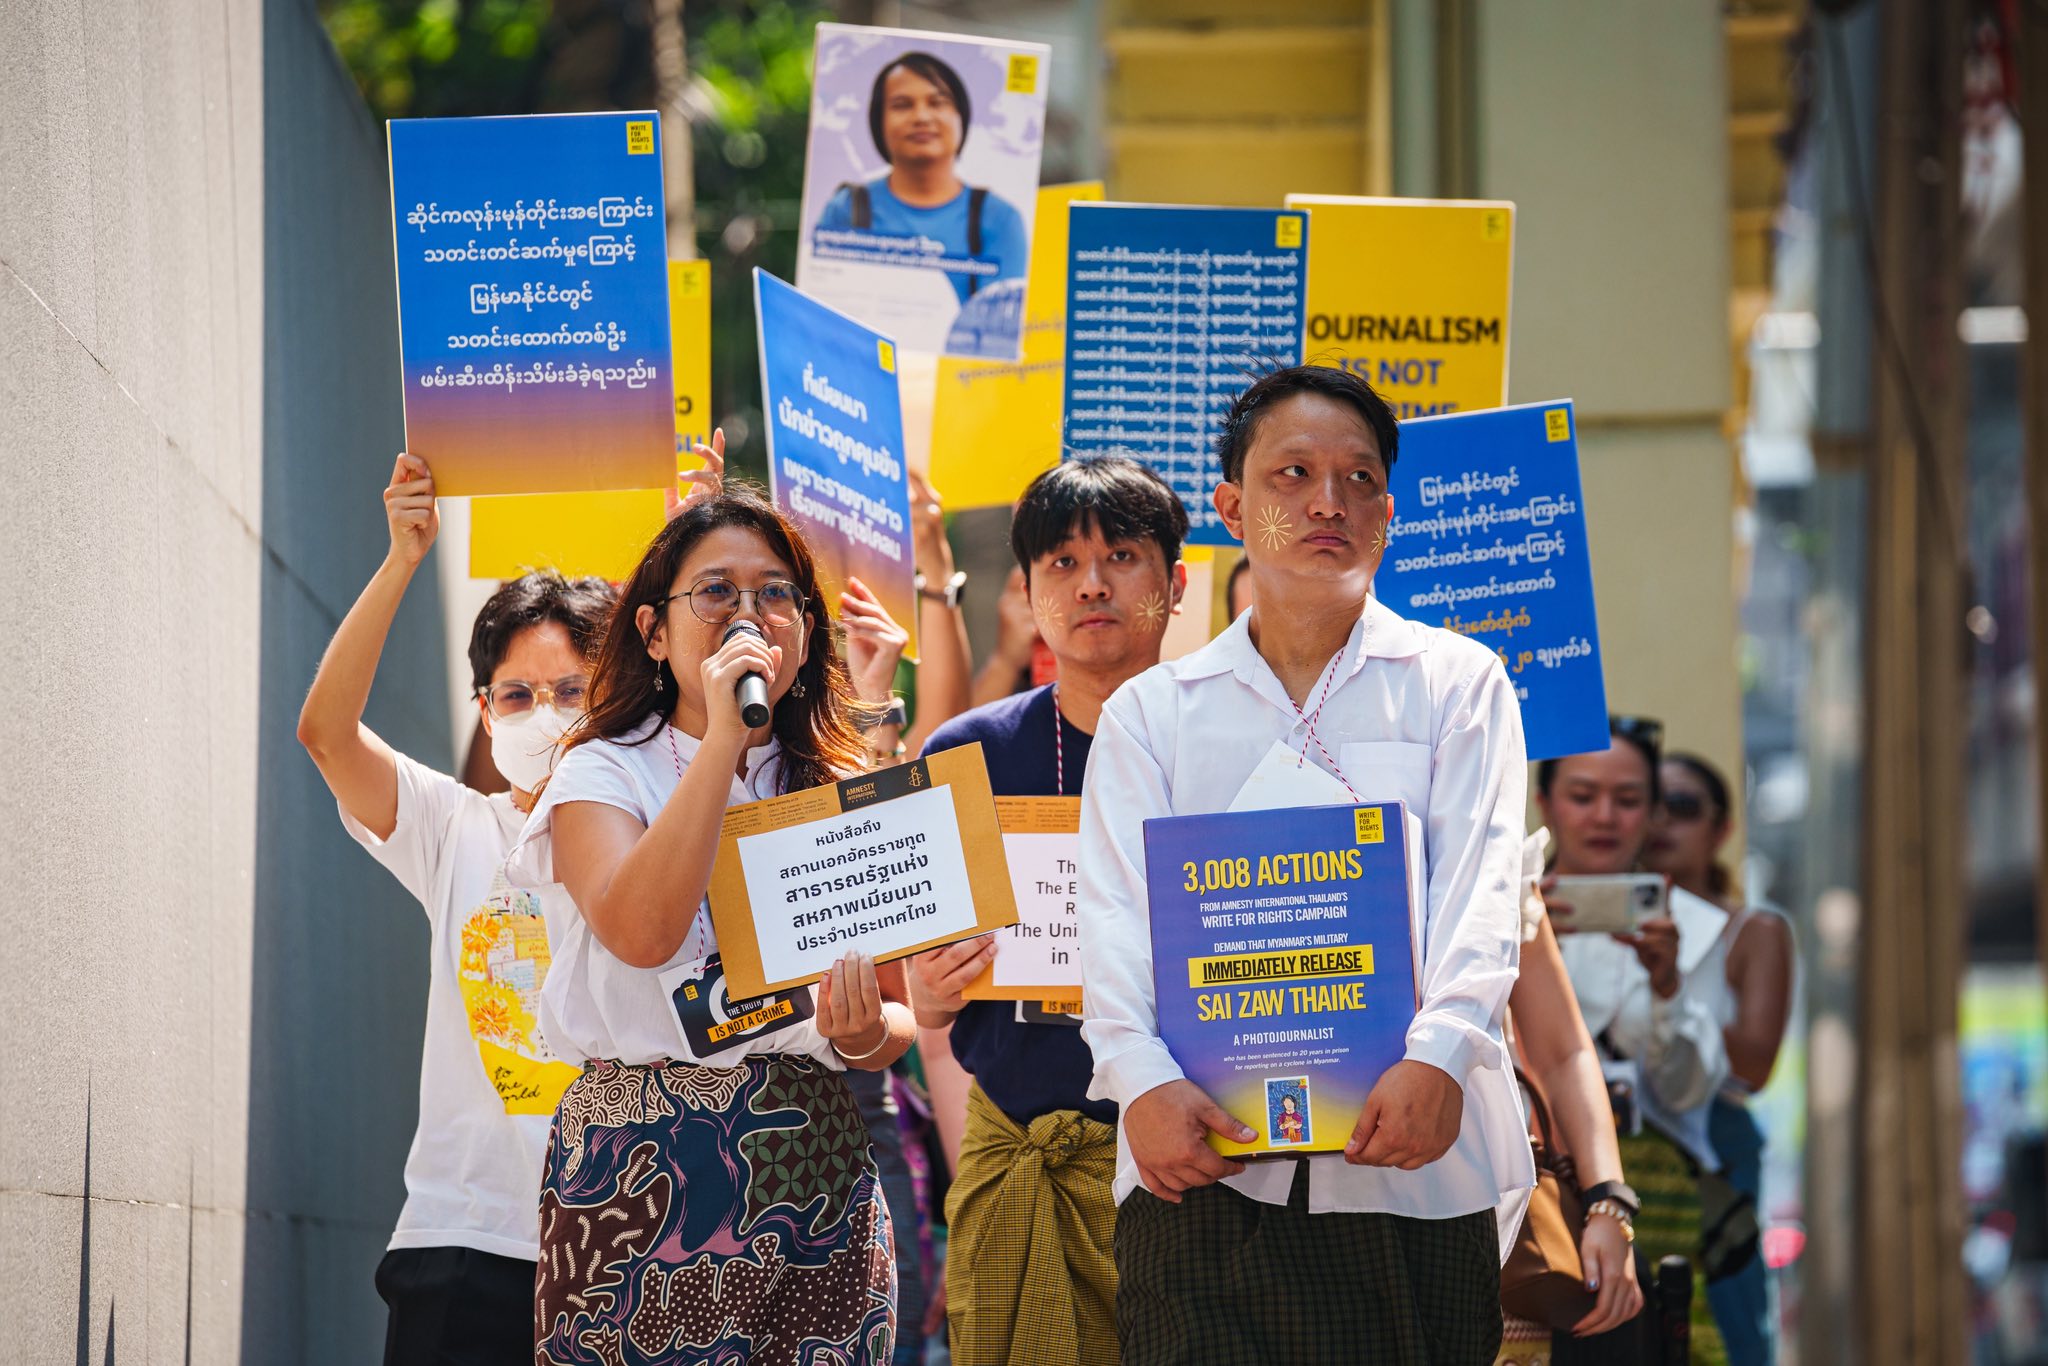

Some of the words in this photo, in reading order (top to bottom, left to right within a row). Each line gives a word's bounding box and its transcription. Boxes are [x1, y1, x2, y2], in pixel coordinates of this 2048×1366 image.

[470, 280, 592, 314] မြန်မာနိုင်ငံတွင်
[1307, 315, 1500, 344] OURNALISM
[1378, 358, 1443, 386] NOT
[846, 782, 874, 796] AMNESTY
[815, 819, 881, 847] หนังสือถึง
[779, 832, 926, 879] สถานเอกอัครราชทูต
[785, 853, 929, 903] สาธารณรัฐแห่ง
[1183, 857, 1250, 896] 3,008
[1257, 848, 1363, 887] ACTIONS
[1036, 881, 1062, 895] The
[792, 879, 932, 929] สหภาพเมียนมา
[1200, 900, 1220, 912] FROM
[1221, 899, 1254, 911] AMNESTY
[1254, 895, 1308, 908] INTERNATIONAL
[796, 902, 937, 951] ประจำประเทศไทย
[1202, 914, 1234, 928] WRITE
[1235, 912, 1256, 927] FOR
[1257, 909, 1293, 925] RIGHTS
[1295, 905, 1347, 921] CAMPAIGN
[1012, 923, 1042, 938] The
[1049, 923, 1078, 938] Uni
[1214, 940, 1246, 953] DEMAND
[1248, 938, 1266, 951] THAT
[1313, 933, 1348, 946] MILITARY
[1052, 947, 1069, 965] in
[1203, 956, 1296, 981] IMMEDIATELY
[1300, 951, 1363, 974] RELEASE
[727, 1006, 740, 1017] THE
[1049, 1001, 1058, 1012] IS
[1060, 1002, 1077, 1014] NOT
[1197, 992, 1232, 1022] SAI
[1238, 988, 1285, 1018] ZAW
[1289, 982, 1367, 1015] THAIKE
[714, 1027, 726, 1038] IS
[727, 1020, 746, 1035] NOT
[748, 1019, 754, 1027] A
[757, 1004, 786, 1024] CRIME
[1234, 1034, 1240, 1046] A
[1243, 1027, 1334, 1045] PHOTOJOURNALIST
[1244, 1062, 1270, 1071] reporting
[1284, 1059, 1305, 1068] cyclone
[1306, 1058, 1312, 1066] in
[1313, 1057, 1340, 1066] Myanmar.
[1248, 1053, 1261, 1061] been
[1262, 1051, 1291, 1060] sentenced
[1308, 1049, 1323, 1057] years
[1332, 1046, 1350, 1055] prison
[502, 1084, 541, 1104] orld
